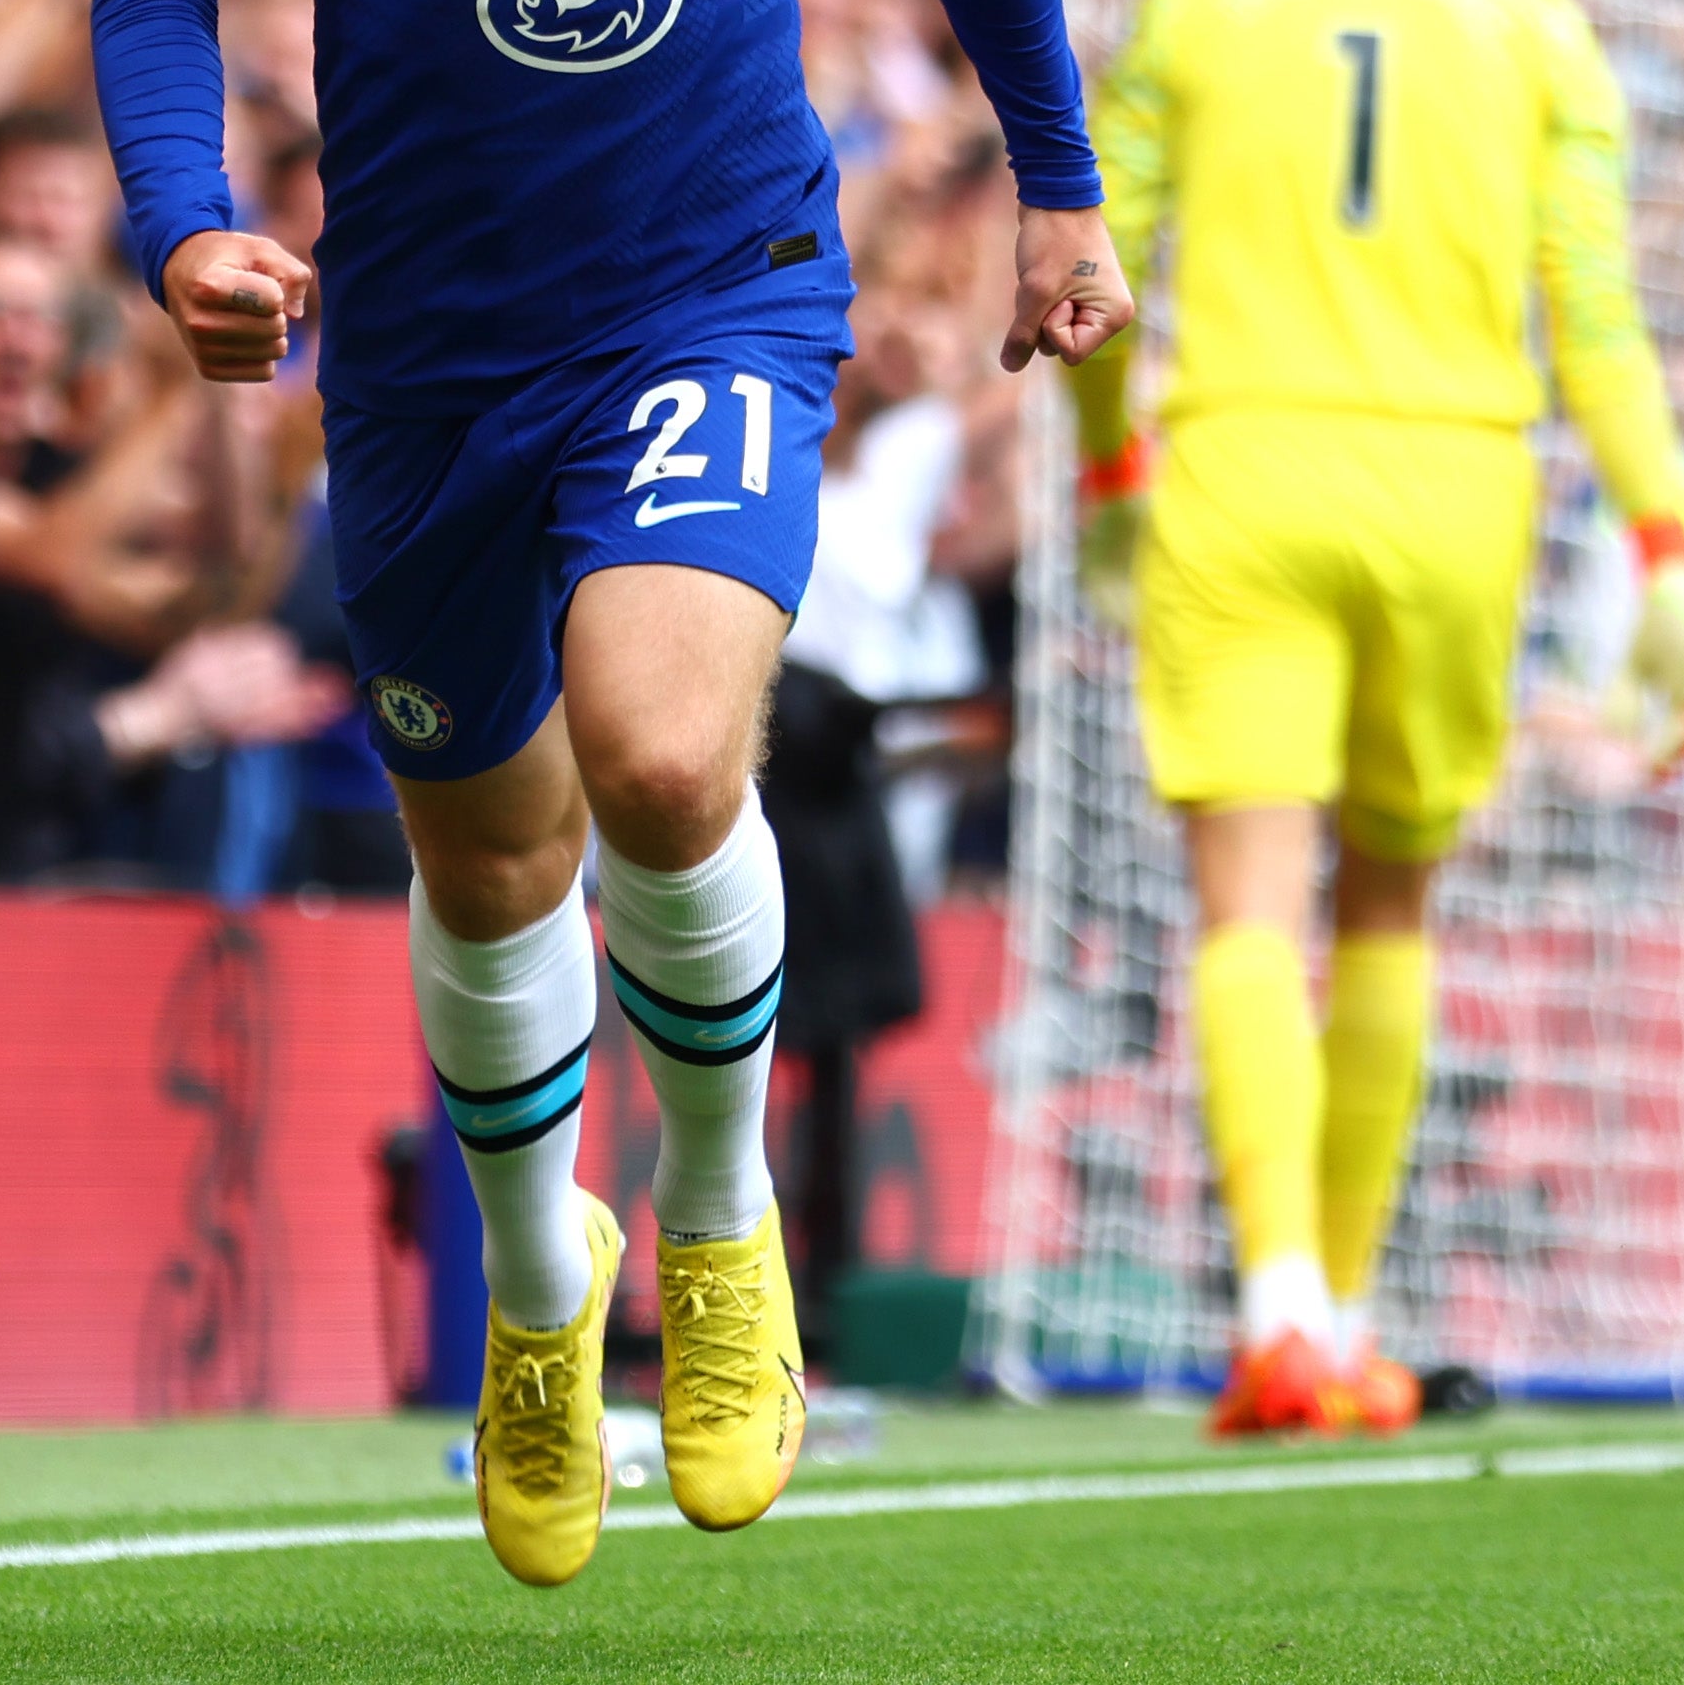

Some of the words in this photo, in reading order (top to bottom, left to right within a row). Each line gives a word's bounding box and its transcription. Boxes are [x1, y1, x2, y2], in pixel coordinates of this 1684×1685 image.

[1334, 30, 1384, 232] 1
[1071, 260, 1098, 277] 21
[624, 374, 772, 497] 21
